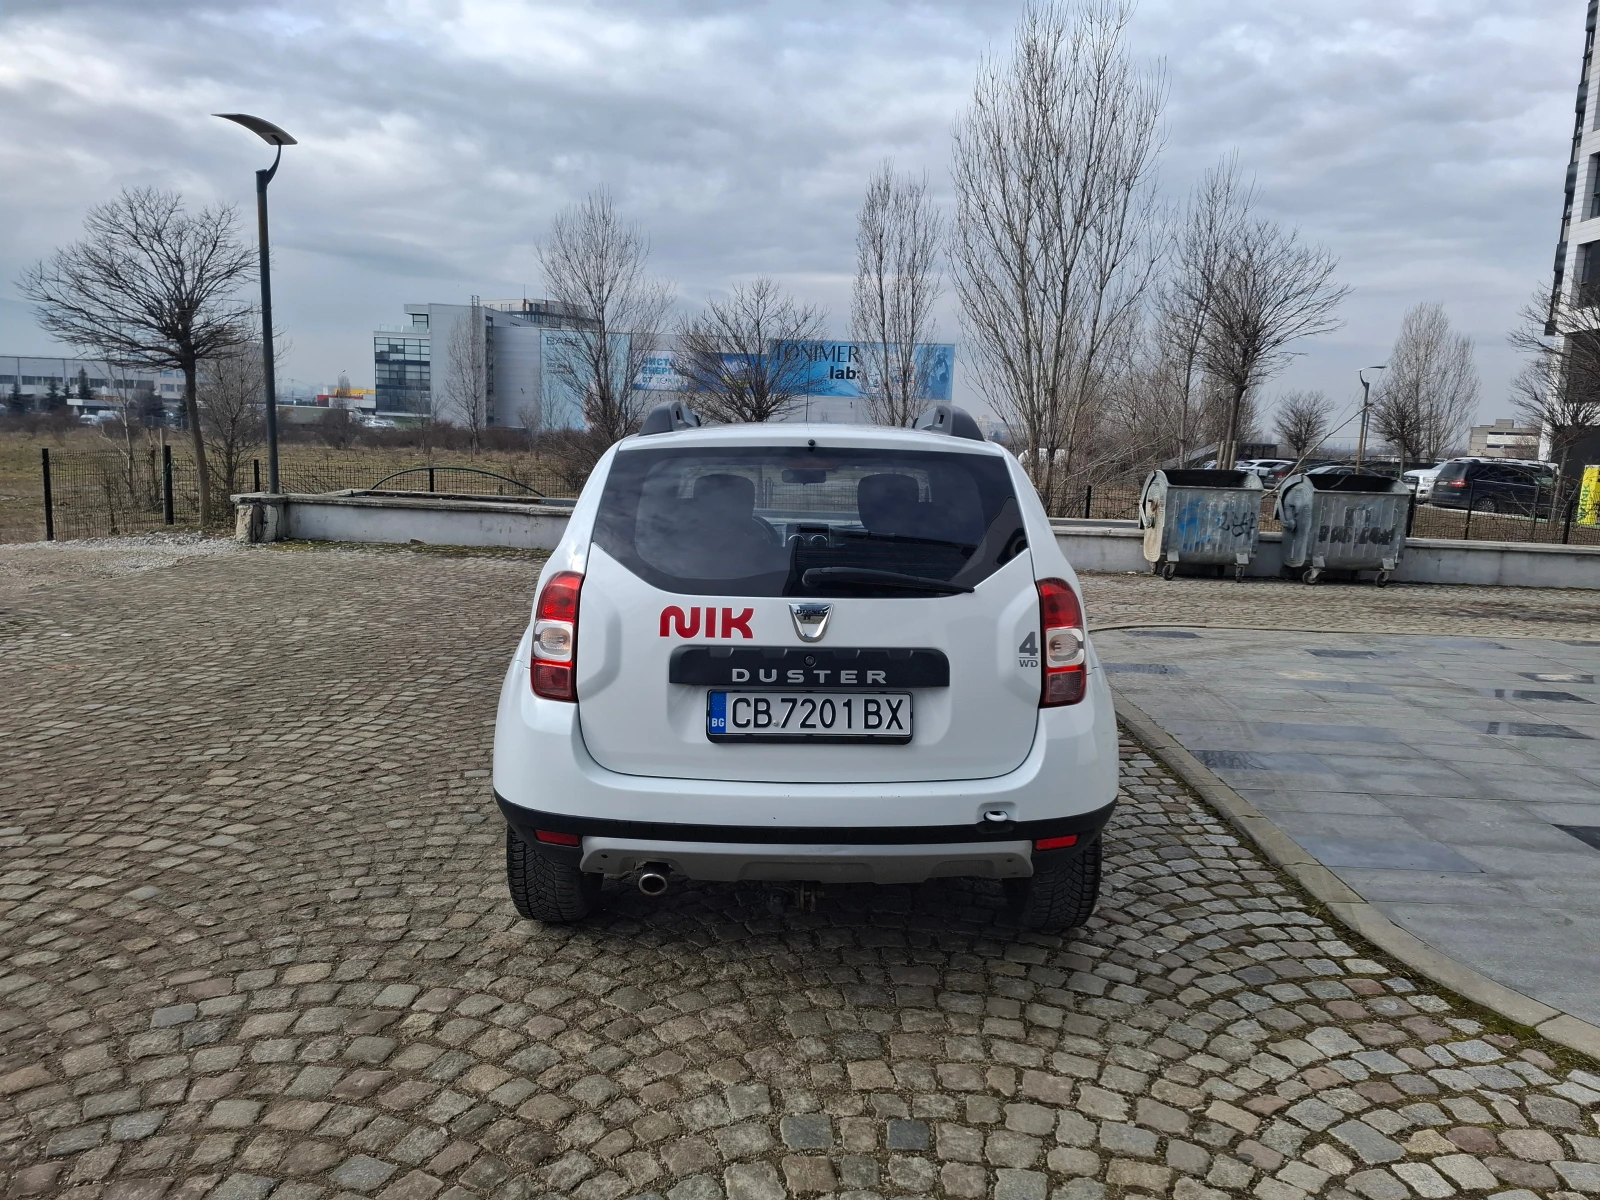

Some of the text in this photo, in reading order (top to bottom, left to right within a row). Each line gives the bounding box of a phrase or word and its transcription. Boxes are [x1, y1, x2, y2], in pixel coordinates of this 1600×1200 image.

[659, 606, 754, 638] NIK
[1018, 631, 1039, 656] 4
[1019, 659, 1038, 668] WD
[732, 668, 887, 684] DUSTER
[711, 717, 725, 728] BG
